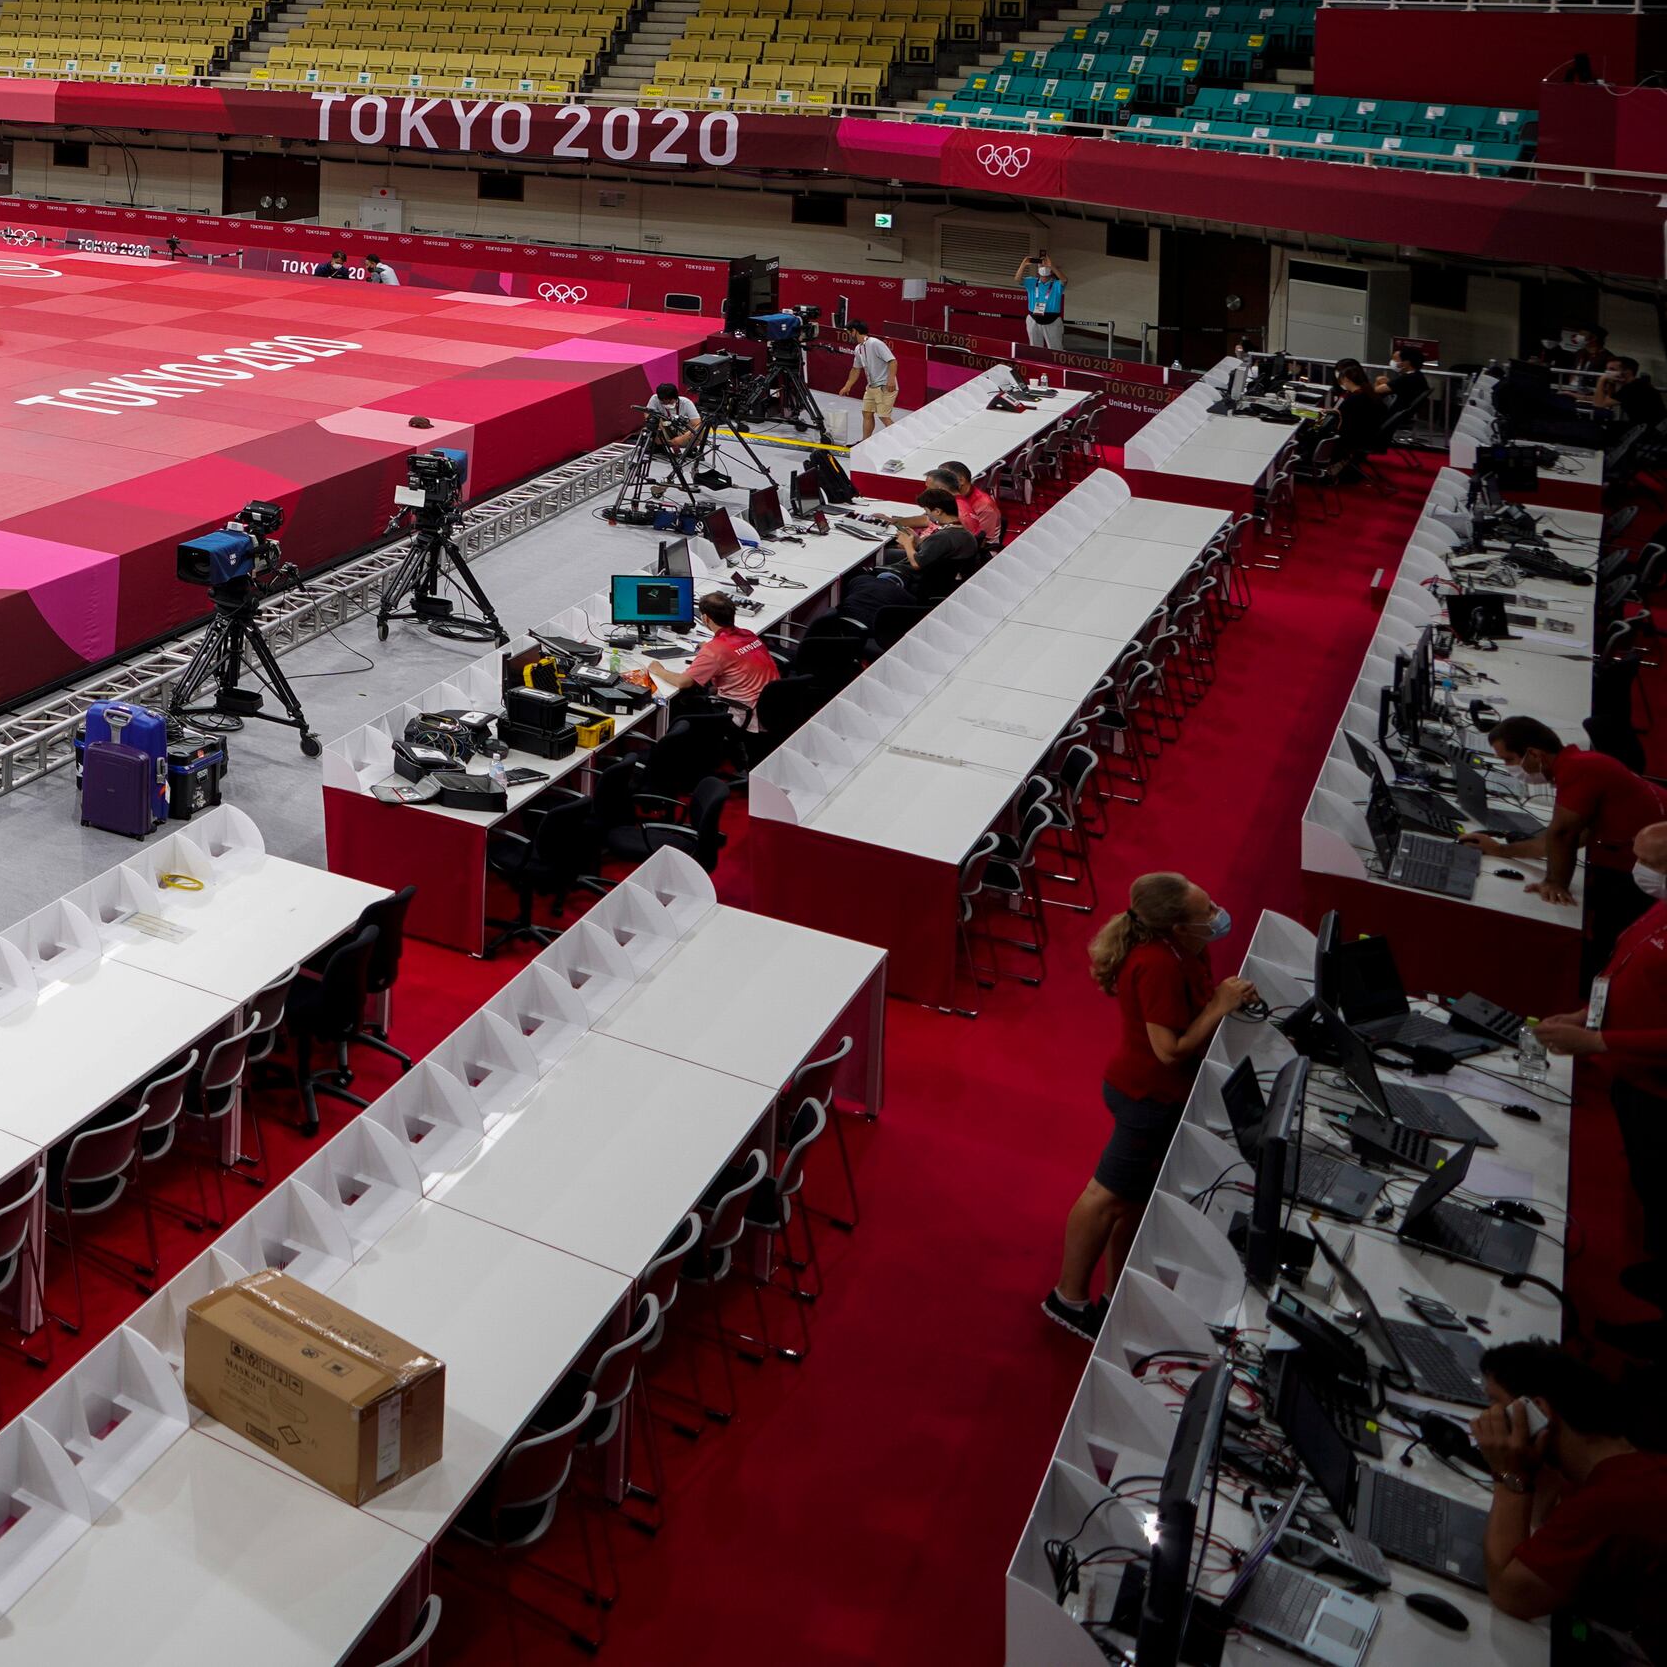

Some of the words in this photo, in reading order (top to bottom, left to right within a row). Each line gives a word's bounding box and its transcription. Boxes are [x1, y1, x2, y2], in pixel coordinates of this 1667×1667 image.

[310, 92, 531, 153] TOKYO
[552, 104, 740, 166] 2020
[78, 238, 118, 253] TOKYO
[120, 242, 151, 257] 2020
[992, 292, 1011, 300] TOKYO
[916, 329, 951, 346] TOKYO
[952, 335, 977, 349] 2020
[1051, 352, 1089, 368] TOKYO
[1091, 358, 1124, 373] 2020
[16, 363, 253, 416] TOKYO
[196, 333, 365, 371] 2020
[1105, 381, 1145, 398] TOKYO
[1109, 399, 1131, 410] United
[1133, 404, 1142, 412] by
[225, 1358, 265, 1388] MASK201
